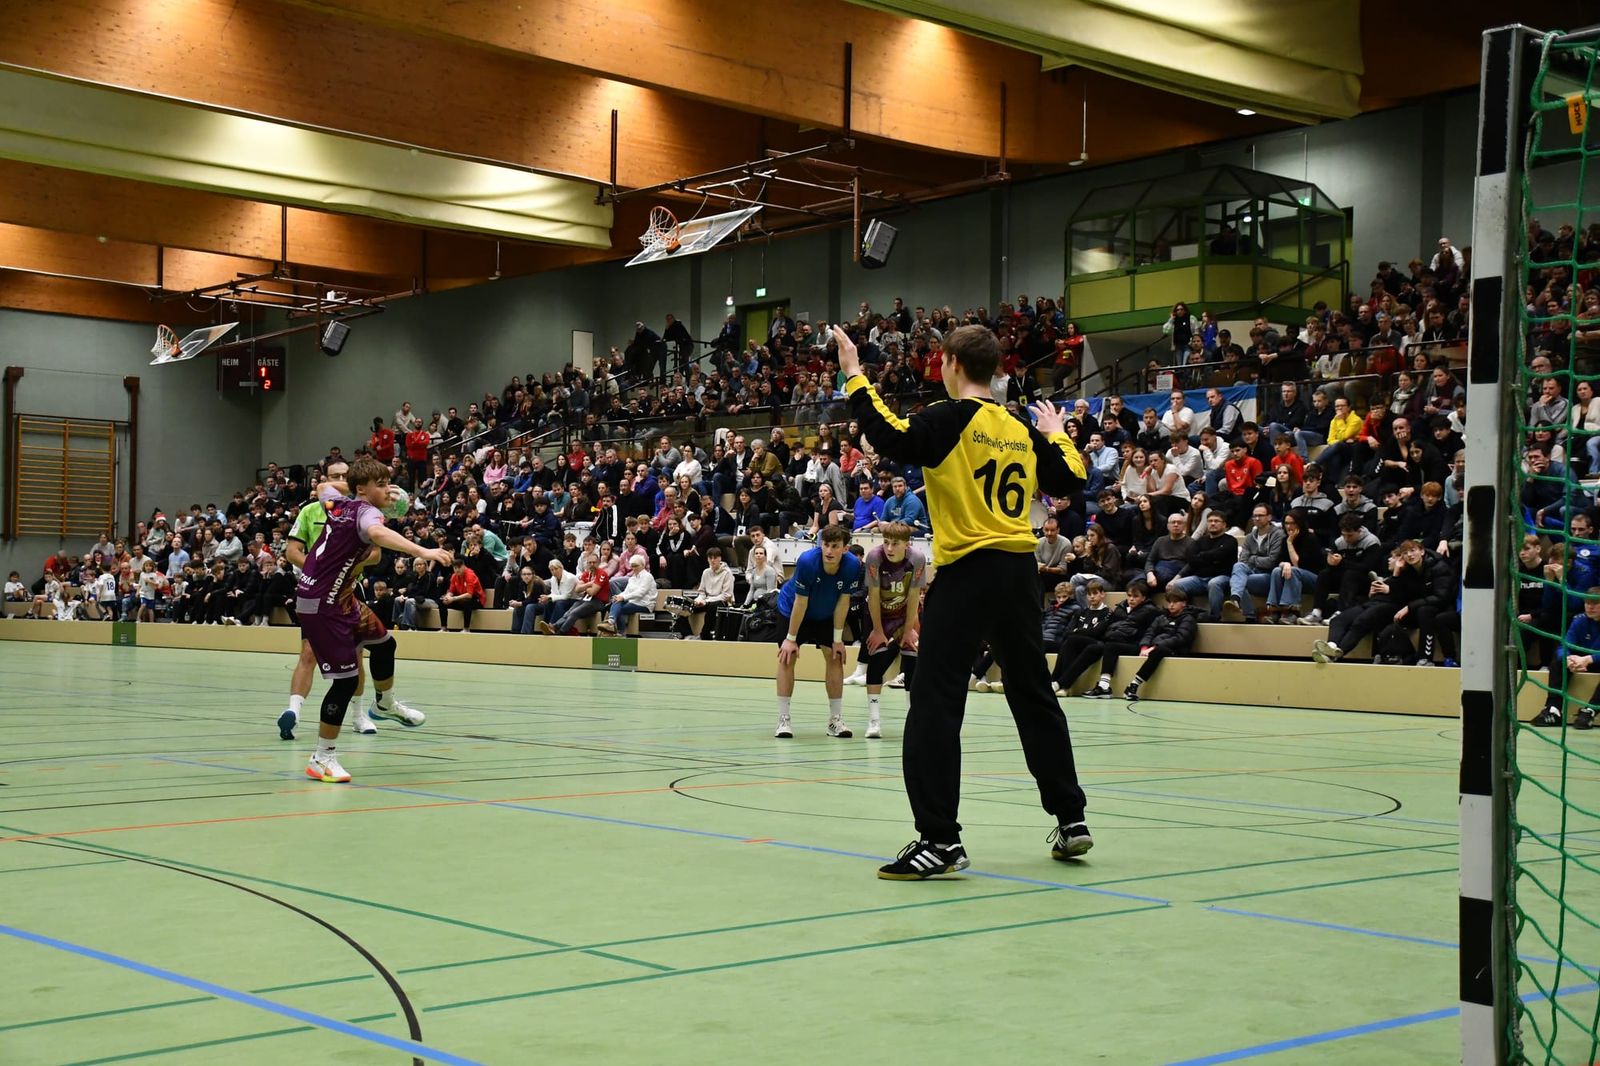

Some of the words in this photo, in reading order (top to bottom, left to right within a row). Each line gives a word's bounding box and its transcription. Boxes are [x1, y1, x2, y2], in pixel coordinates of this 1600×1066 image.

[222, 358, 239, 367] HEIM
[257, 357, 279, 367] GÄSTE
[260, 367, 266, 377] 1
[264, 379, 271, 389] 2
[973, 458, 1027, 519] 16
[106, 581, 115, 591] 18
[326, 557, 356, 605] HANDBALL
[890, 581, 905, 593] 19
